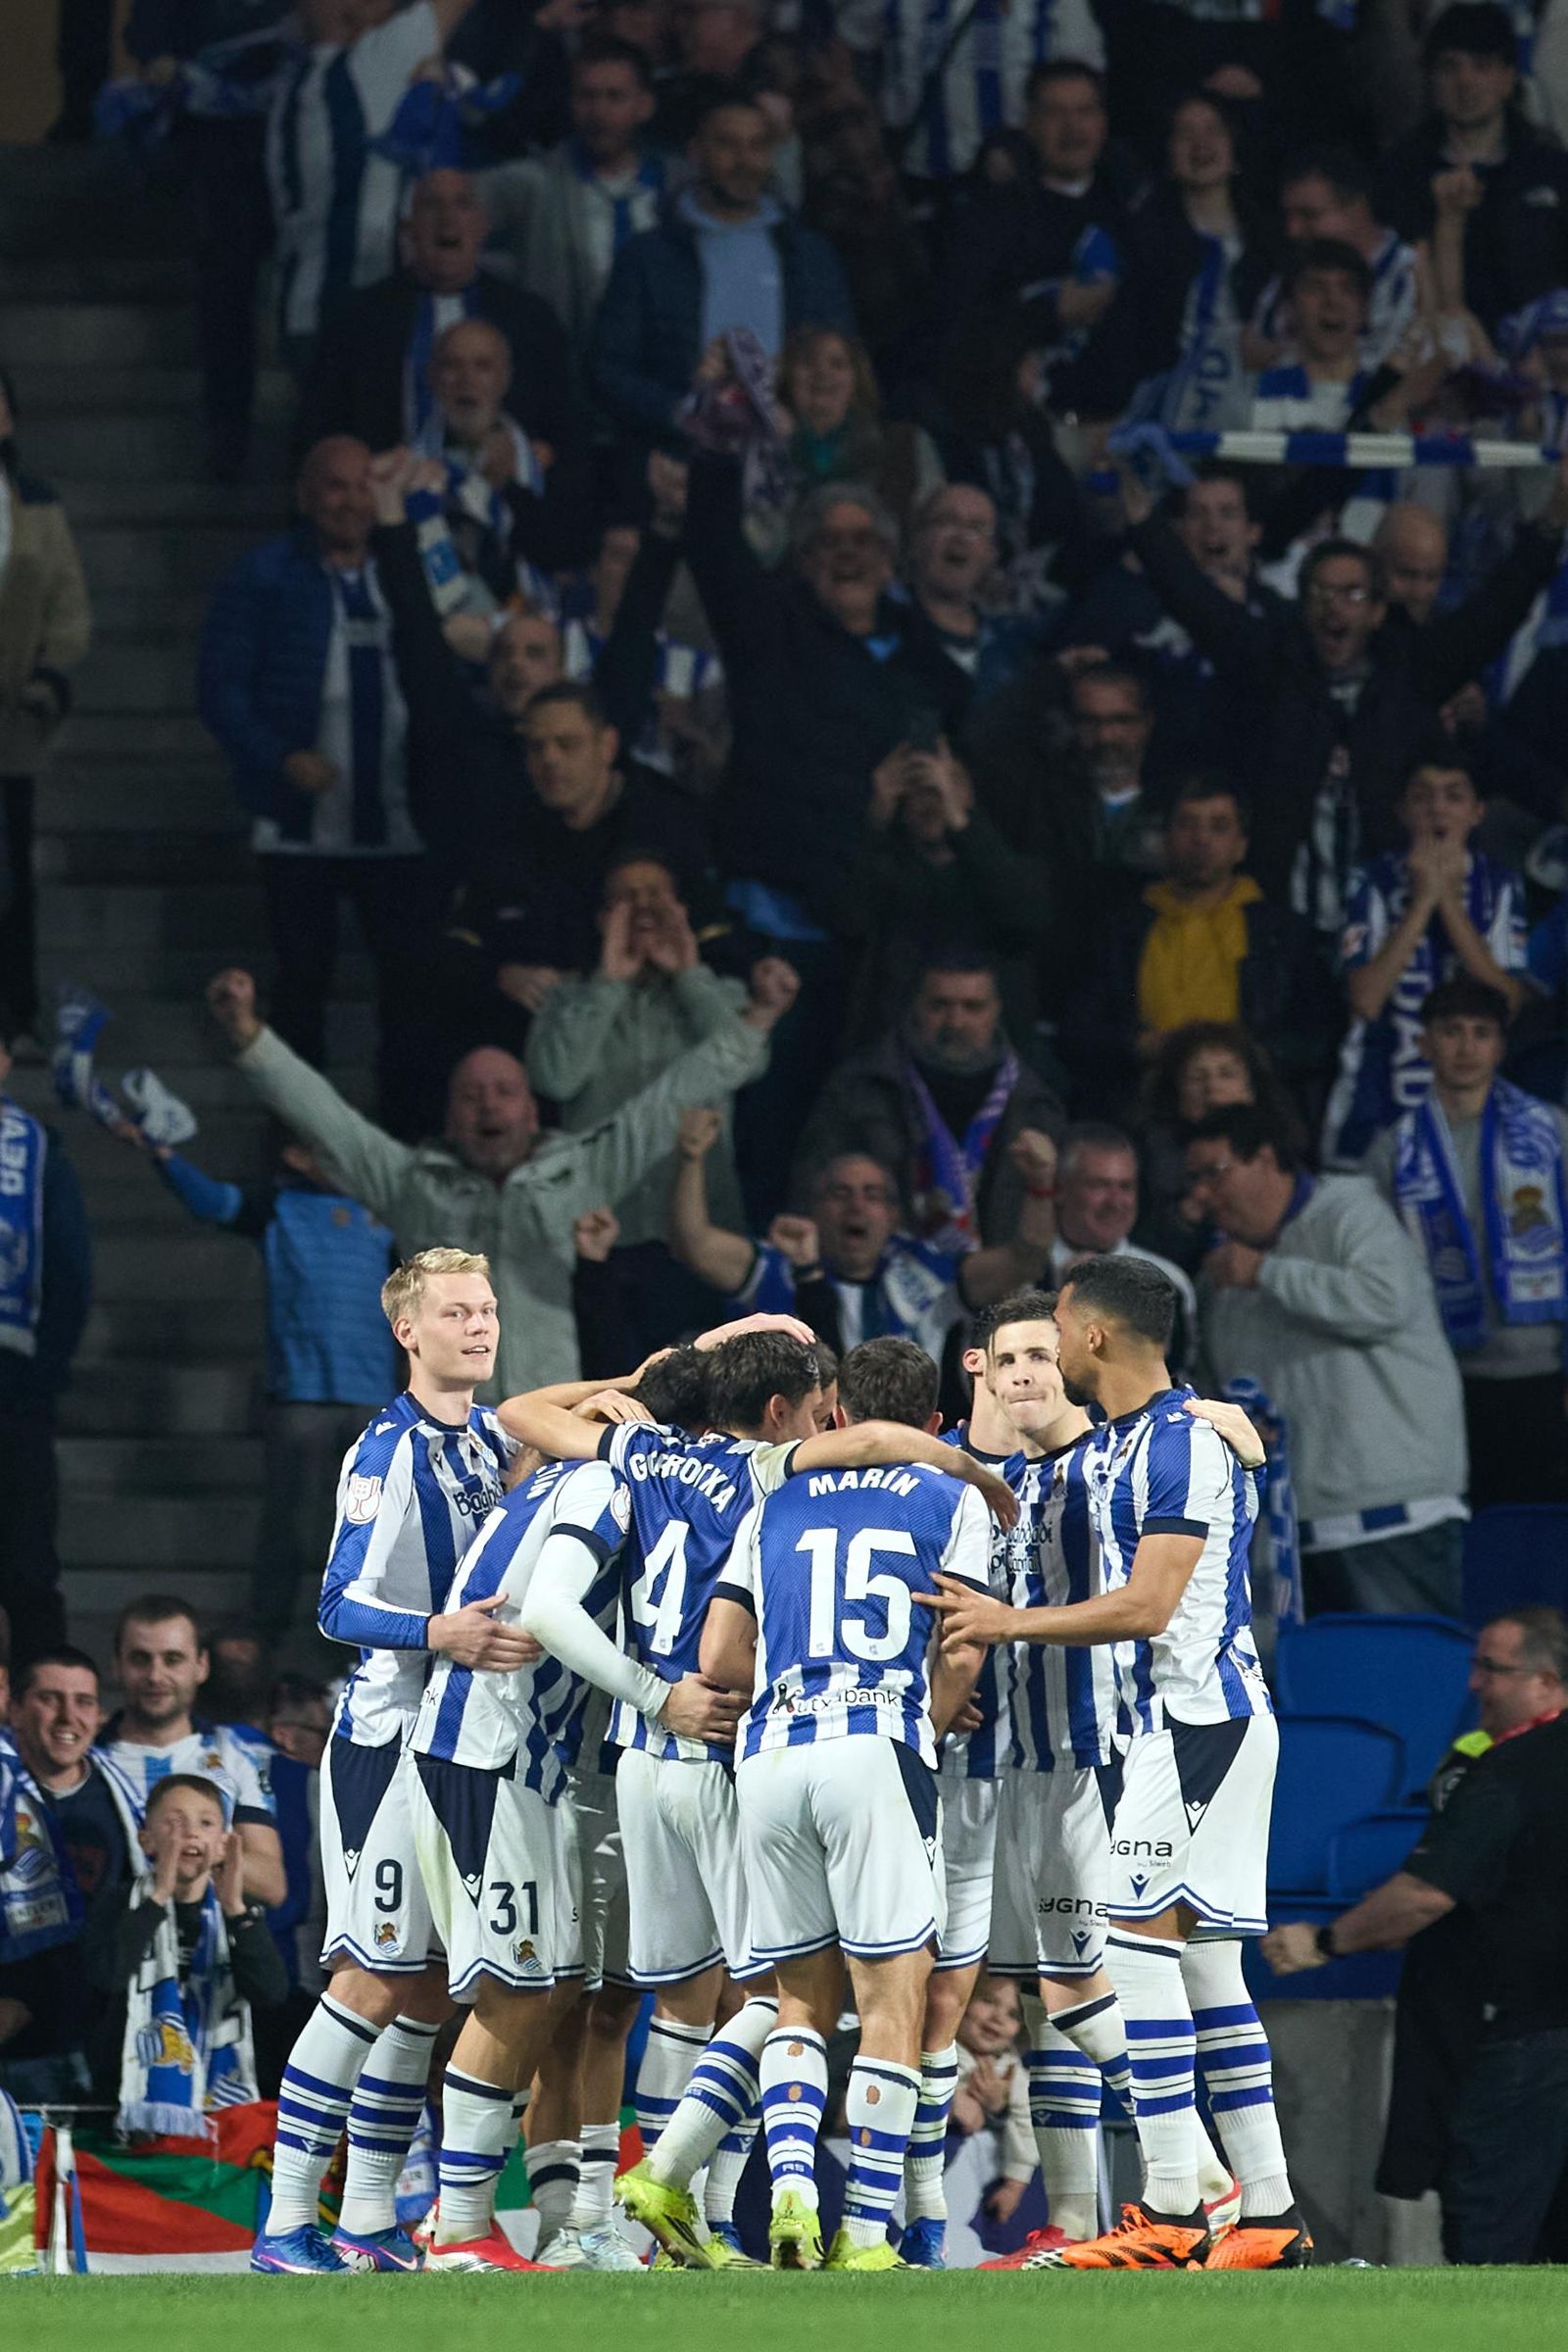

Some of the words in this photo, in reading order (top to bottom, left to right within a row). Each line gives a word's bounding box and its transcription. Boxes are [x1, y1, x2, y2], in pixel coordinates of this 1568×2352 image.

[808, 1466, 920, 1497] MARÍN
[632, 1519, 690, 1656] 4
[795, 1528, 916, 1662] 15
[374, 1859, 403, 1912] 9
[490, 1881, 539, 1936] 31
